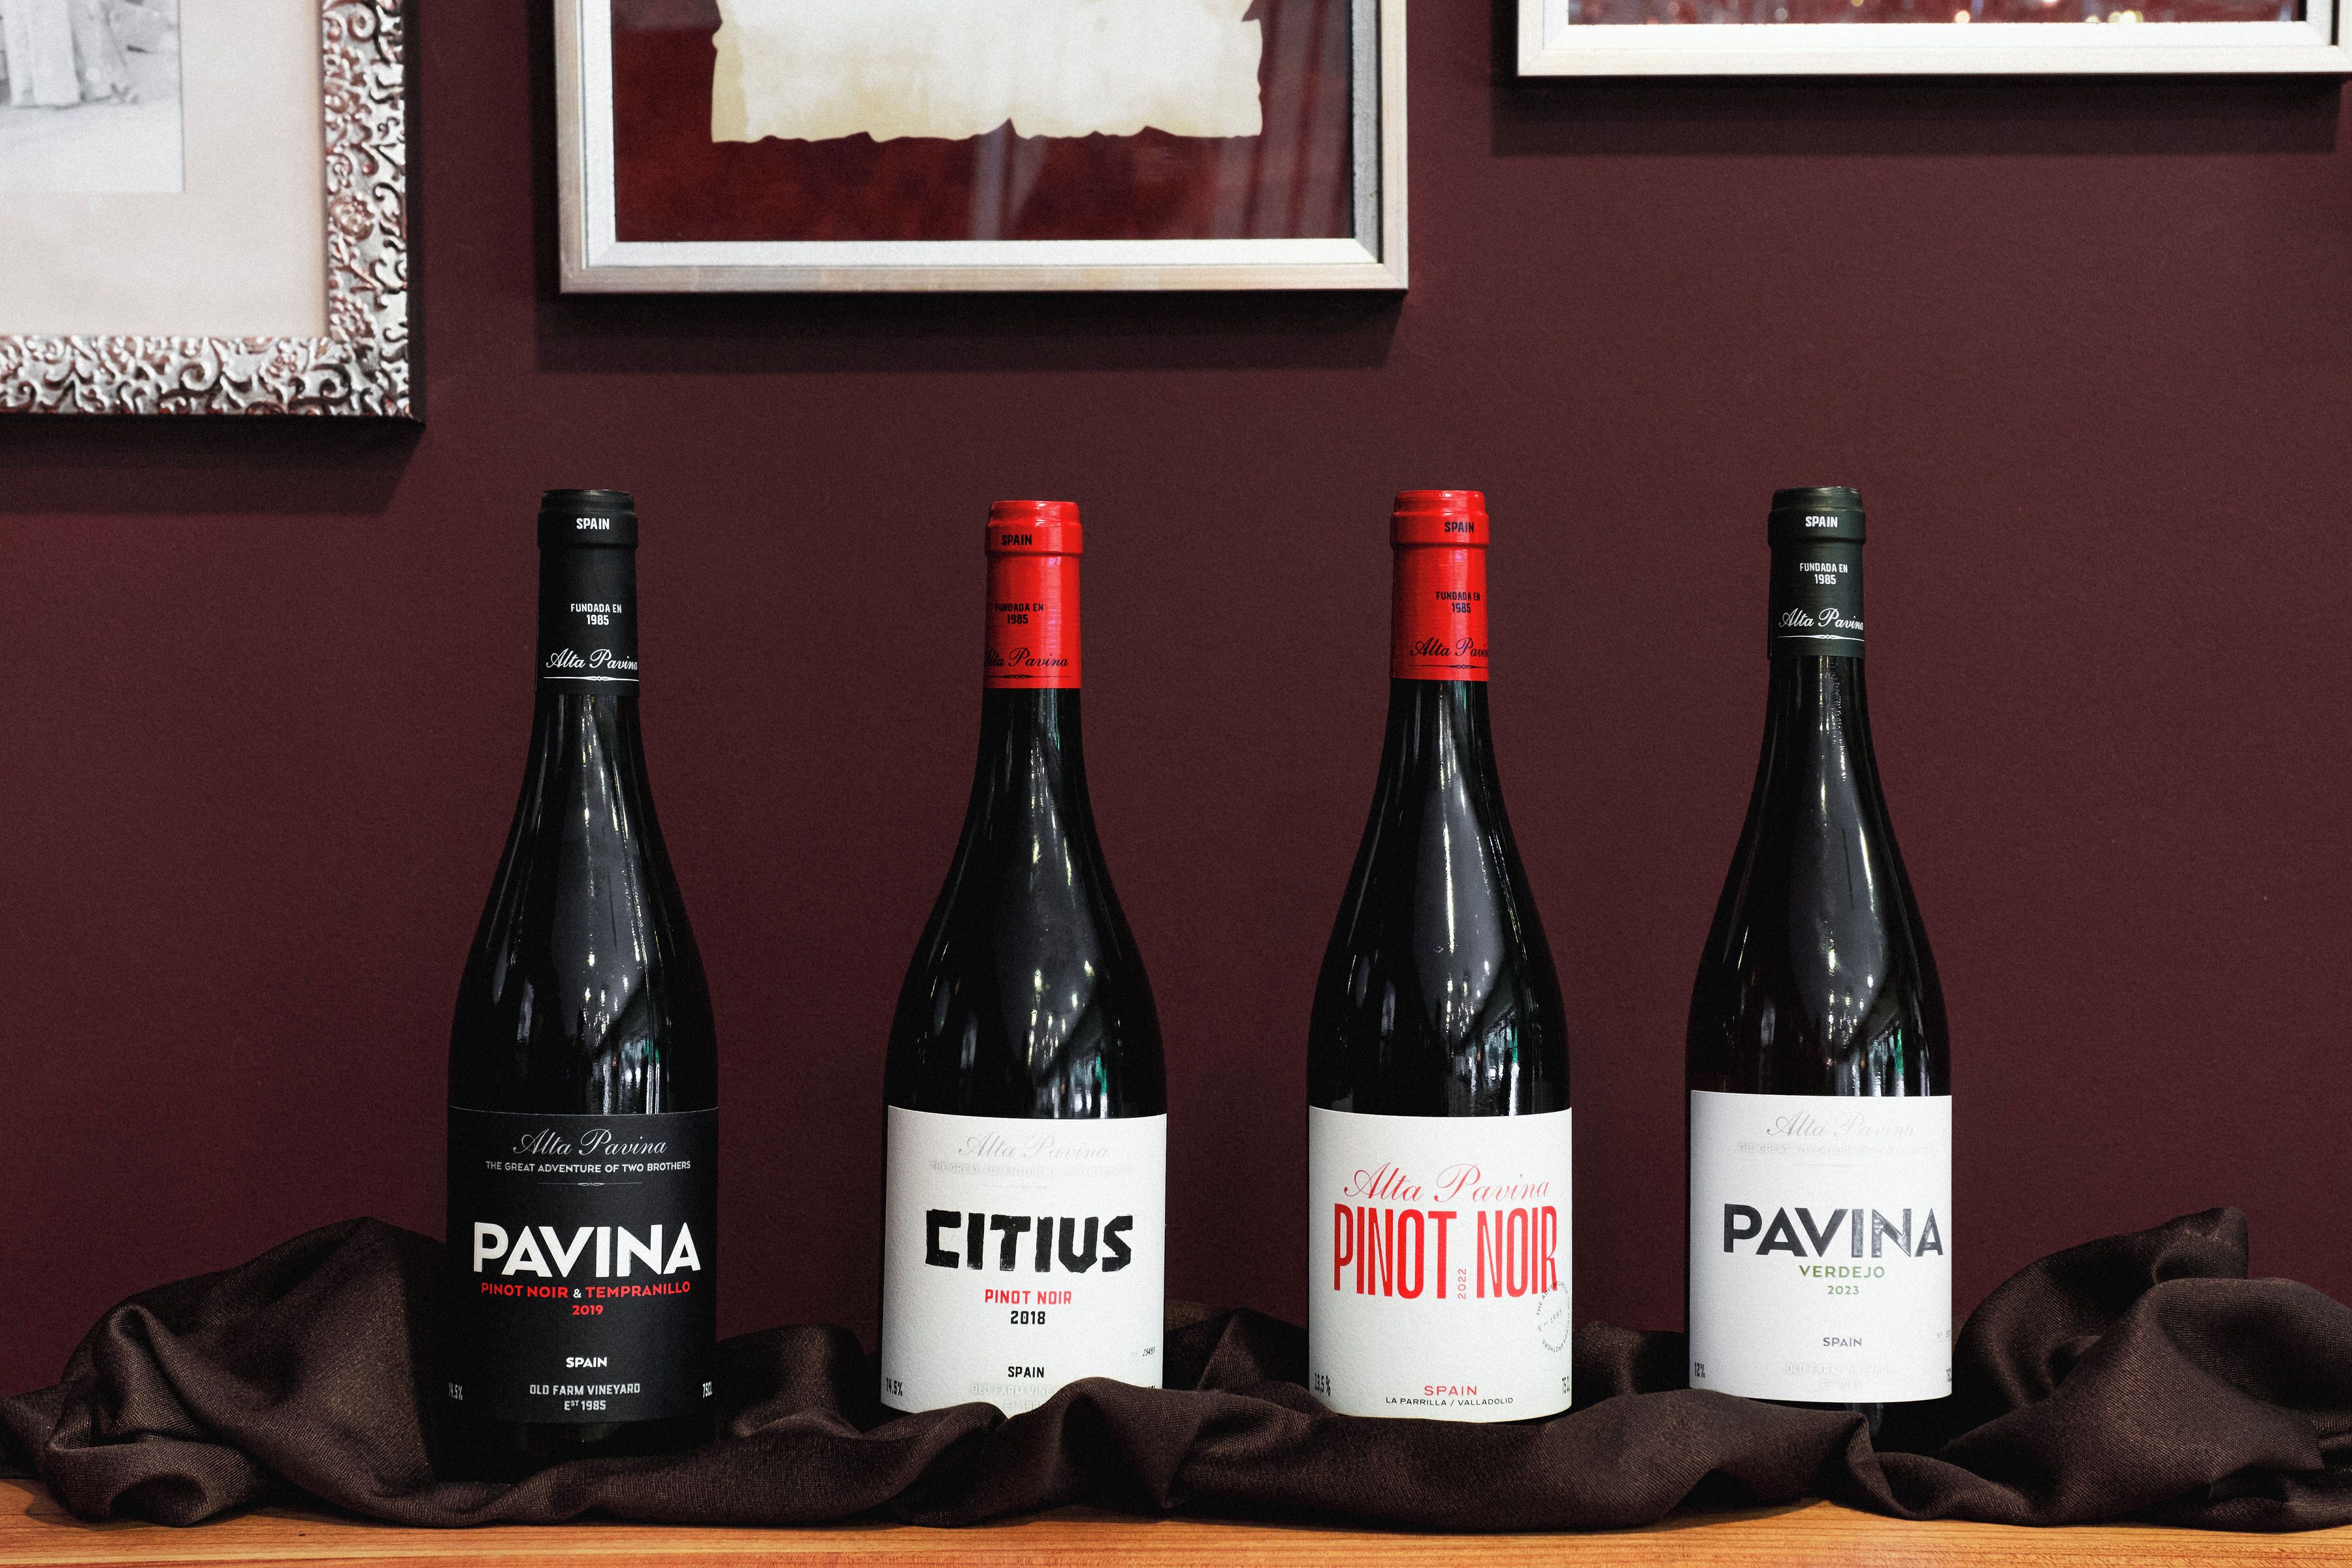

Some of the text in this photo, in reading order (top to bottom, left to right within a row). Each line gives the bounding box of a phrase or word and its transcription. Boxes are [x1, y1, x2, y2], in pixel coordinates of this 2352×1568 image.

[577, 518, 610, 530] SPAIN
[1444, 521, 1475, 533] SPAIN
[1806, 516, 1838, 527] SPAIN
[1001, 534, 1032, 546] SPAIN
[1800, 563, 1848, 573] FUNDADA EN
[1815, 574, 1836, 585] 1985
[1435, 591, 1480, 601] FUNDADA EN
[571, 604, 621, 613] FUNDADA EN
[995, 602, 1044, 612] FUNDADA EN
[1451, 602, 1472, 613] 1985
[587, 615, 609, 625] 1985
[1006, 613, 1029, 625] 1985
[1779, 608, 1863, 630] Alta Pavina
[1410, 636, 1451, 657] Alta
[546, 648, 637, 670] Alta Pavina
[1007, 647, 1069, 668] Pavina
[1767, 1111, 1825, 1136] Alta
[514, 1129, 666, 1155] Alta Pavina
[958, 1132, 1109, 1159] Alta Pavina
[486, 1161, 502, 1169] THE
[505, 1163, 535, 1171] GREAT
[538, 1164, 601, 1173] ADVENTURE
[622, 1164, 644, 1172] TWO
[647, 1161, 690, 1171] BROTHERS
[1344, 1162, 1550, 1202] Alta Pavina
[1724, 1203, 1943, 1258] PAVINA
[925, 1209, 1134, 1273] CITIUS
[474, 1222, 700, 1277] PAVINA
[1334, 1203, 1558, 1299] PINOT NOIR
[1798, 1265, 1886, 1279] VERDEJO
[482, 1281, 690, 1298] PINOT NOIR & TEMPRANILLO
[1458, 1268, 1467, 1299] 2022
[1827, 1286, 1859, 1295] 2023
[985, 1289, 1071, 1305] PINOT NOIR
[572, 1305, 604, 1316] 2019
[1550, 1308, 1563, 1324] 1985
[1011, 1311, 1045, 1324] 2018
[1822, 1337, 1862, 1347] SPAIN
[566, 1357, 607, 1367] SPAIN
[1008, 1366, 1044, 1378] SPAIN
[1695, 1362, 1705, 1378] 12%
[530, 1383, 640, 1395] OLD FARM VINEYARD
[887, 1378, 902, 1396] 14.5%
[1424, 1385, 1477, 1396] SPAIN
[581, 1400, 606, 1411] 1985
